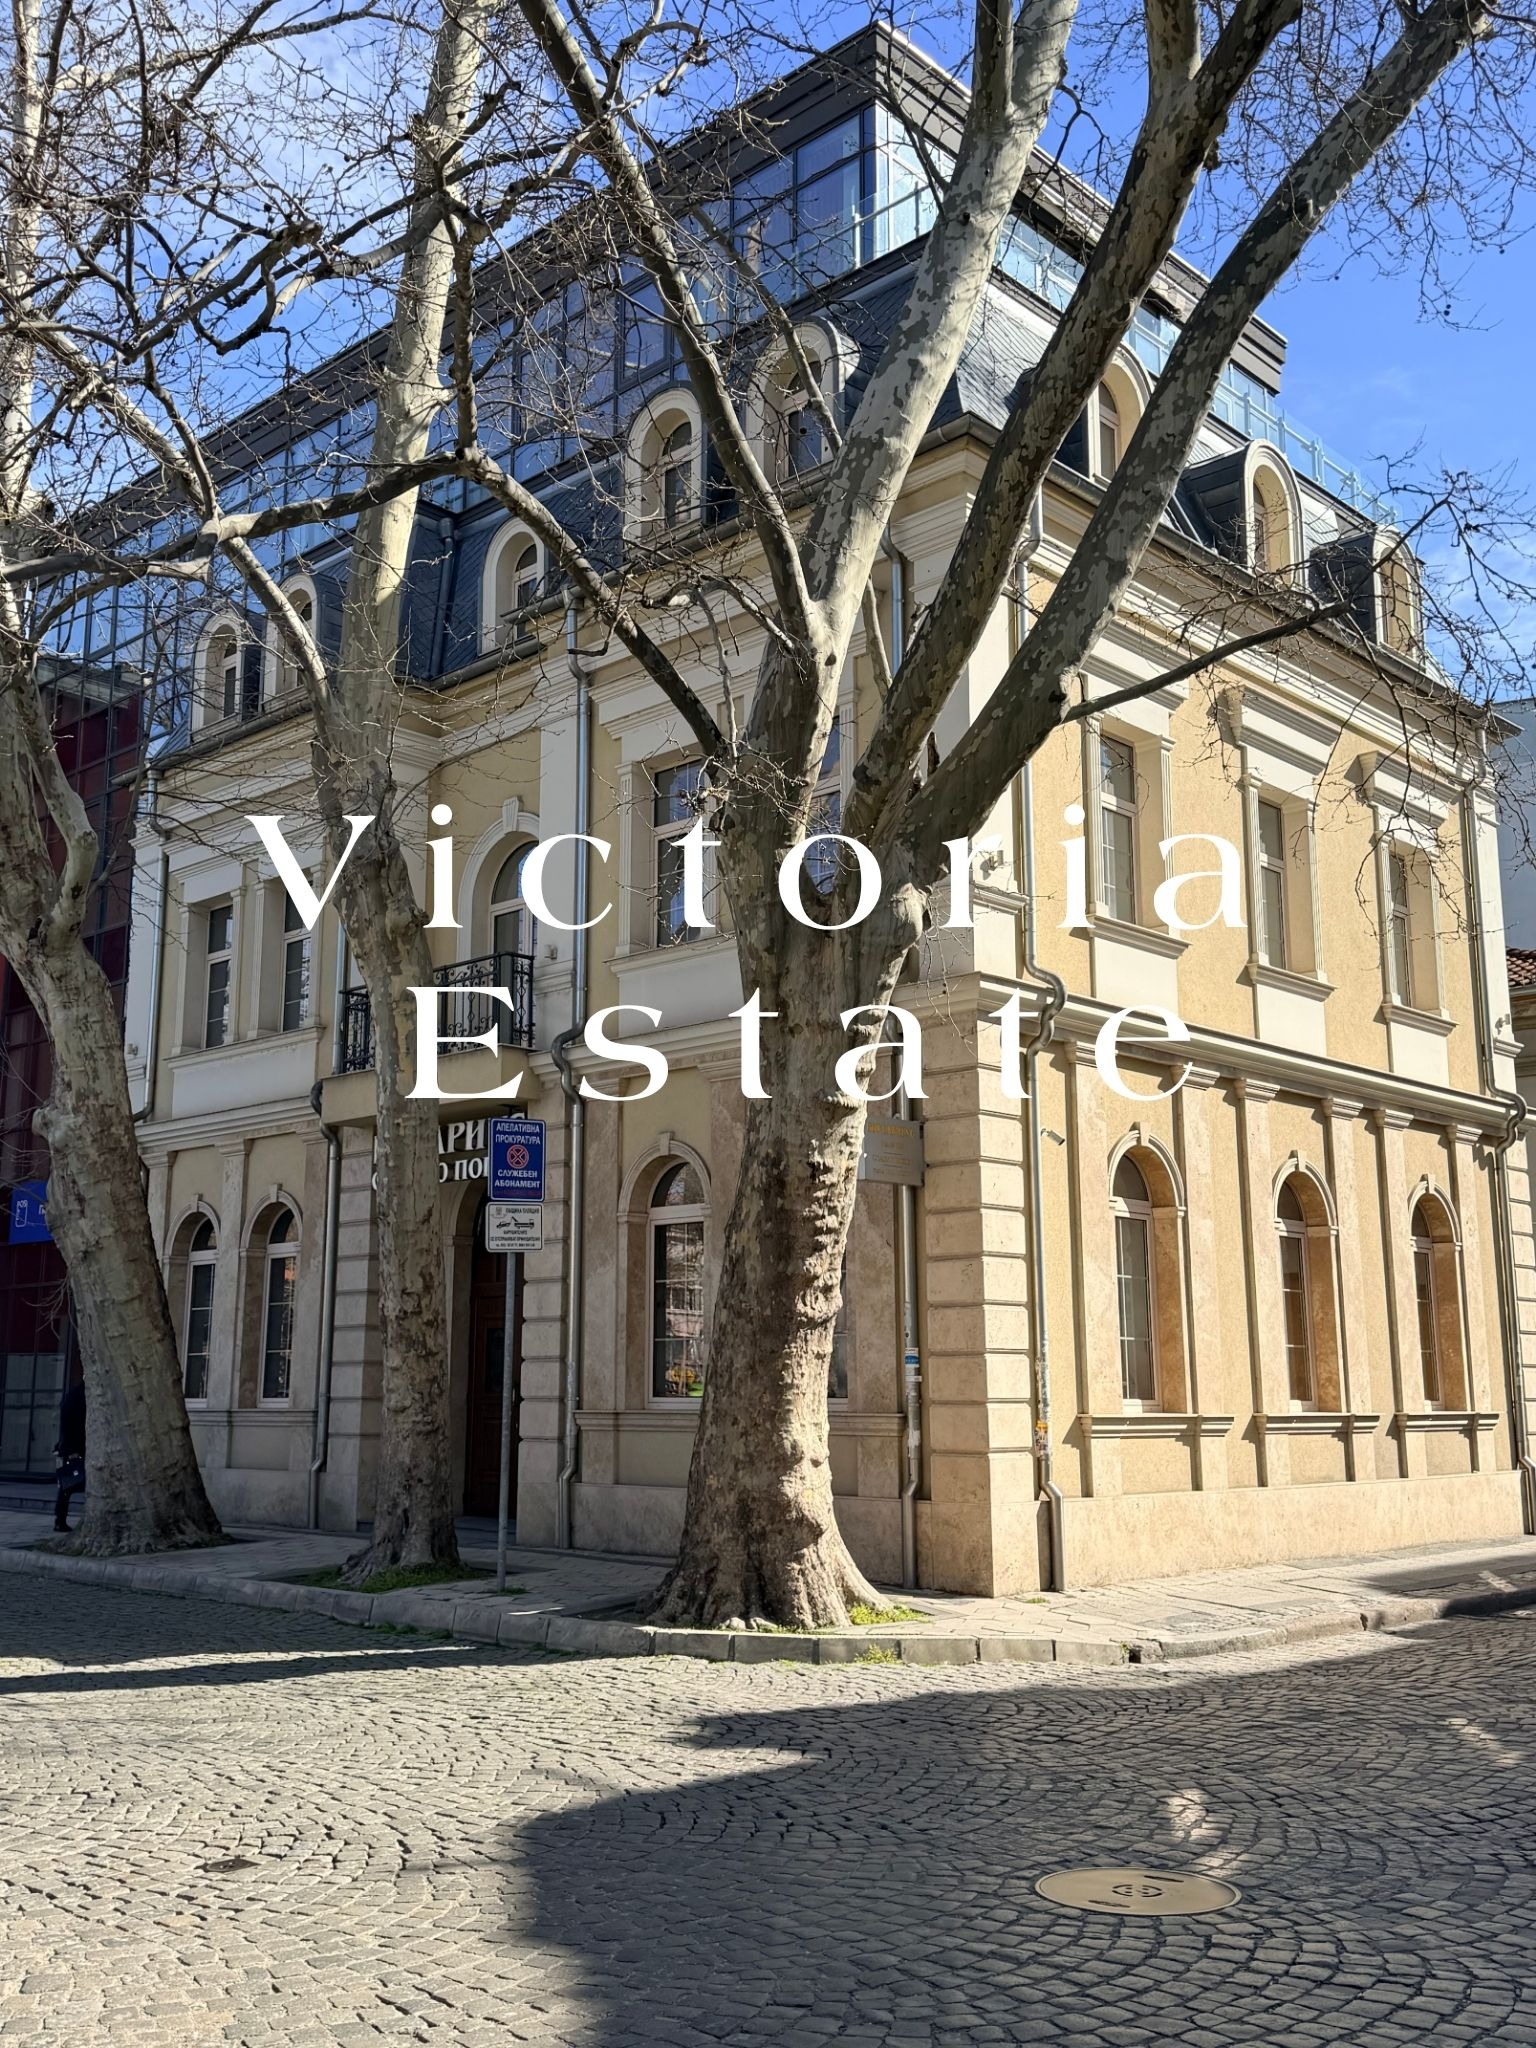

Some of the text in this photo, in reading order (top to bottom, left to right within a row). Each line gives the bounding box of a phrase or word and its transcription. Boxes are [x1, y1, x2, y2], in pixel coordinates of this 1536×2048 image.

[495, 1134, 541, 1145] ПРОКУРАТУРА
[497, 1169, 538, 1178] СЛУЖЕБЕН
[494, 1179, 540, 1188] АБОНАМЕНТ
